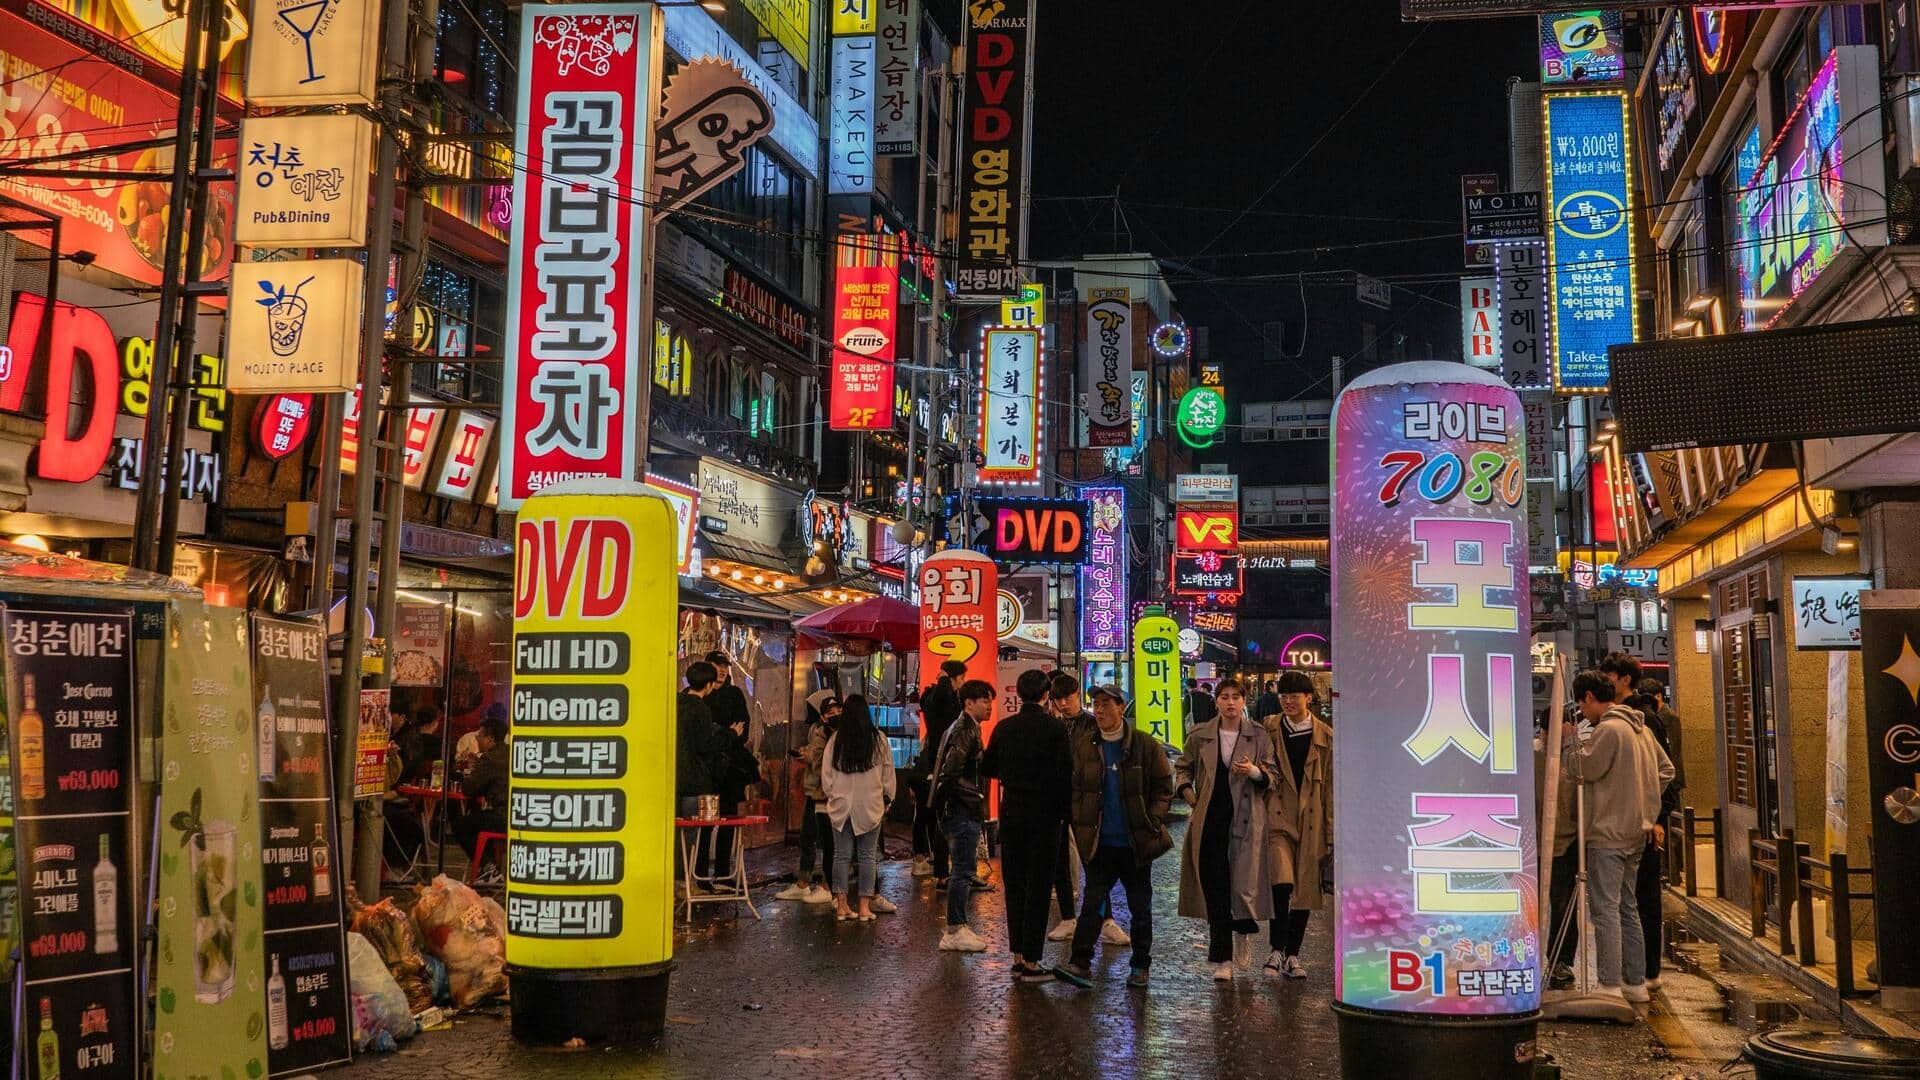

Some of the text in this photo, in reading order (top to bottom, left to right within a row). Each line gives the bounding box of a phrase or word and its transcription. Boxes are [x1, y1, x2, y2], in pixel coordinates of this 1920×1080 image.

[1546, 57, 1573, 78] B1
[973, 34, 1014, 142] DVD
[90, 94, 124, 126] 이야기
[248, 142, 304, 188] 청춘
[291, 168, 344, 201] 예찬
[253, 210, 331, 225] Pub&Dining
[968, 149, 1011, 257] 영화관
[535, 100, 615, 450] 꼼보포차
[958, 268, 1018, 291] 진동의자
[1571, 273, 1614, 284] 탄산소주
[850, 295, 881, 307] 신개념
[864, 308, 890, 320] BAR
[1508, 248, 1537, 364] 민호헤어
[1573, 310, 1616, 320] 수입맥주
[1471, 287, 1493, 357] BAR
[244, 361, 325, 375] MOJITO PLACE
[1202, 372, 1220, 385] 24
[1512, 369, 1539, 385] 2층
[997, 337, 1023, 460] 육회본가
[847, 408, 878, 427] 2F
[1403, 401, 1507, 445] 라이브
[446, 423, 485, 488] 포
[1378, 450, 1526, 509] 7080
[996, 507, 1083, 553] DVD
[1181, 516, 1234, 544] VR
[513, 518, 632, 619] DVD
[1092, 528, 1115, 631] 노래연습장
[1180, 572, 1234, 588] 노래연습장
[923, 565, 982, 613] 육회
[10, 618, 126, 658] 청춘예찬
[922, 613, 985, 633] 18,000원
[258, 625, 319, 662] 청춘예찬
[516, 639, 619, 670] Full HD
[1143, 640, 1170, 651] 넥타이
[1289, 650, 1326, 666] TOL
[513, 691, 620, 721] Cinema
[1146, 659, 1171, 743] 마사지
[1401, 516, 1523, 914] 포시즌
[54, 710, 80, 728] 호세
[512, 741, 618, 775] 대형스크린
[58, 768, 120, 792] ₩69,000
[511, 794, 616, 827] 진동의자
[32, 868, 80, 890] 스미노프
[33, 893, 80, 915] 그린애플
[508, 897, 612, 935] 무료셀프바
[295, 972, 329, 994] 앱솔루트
[1388, 950, 1447, 997] B1
[1456, 967, 1536, 997] 단란주점
[76, 1042, 117, 1070] 아구아
